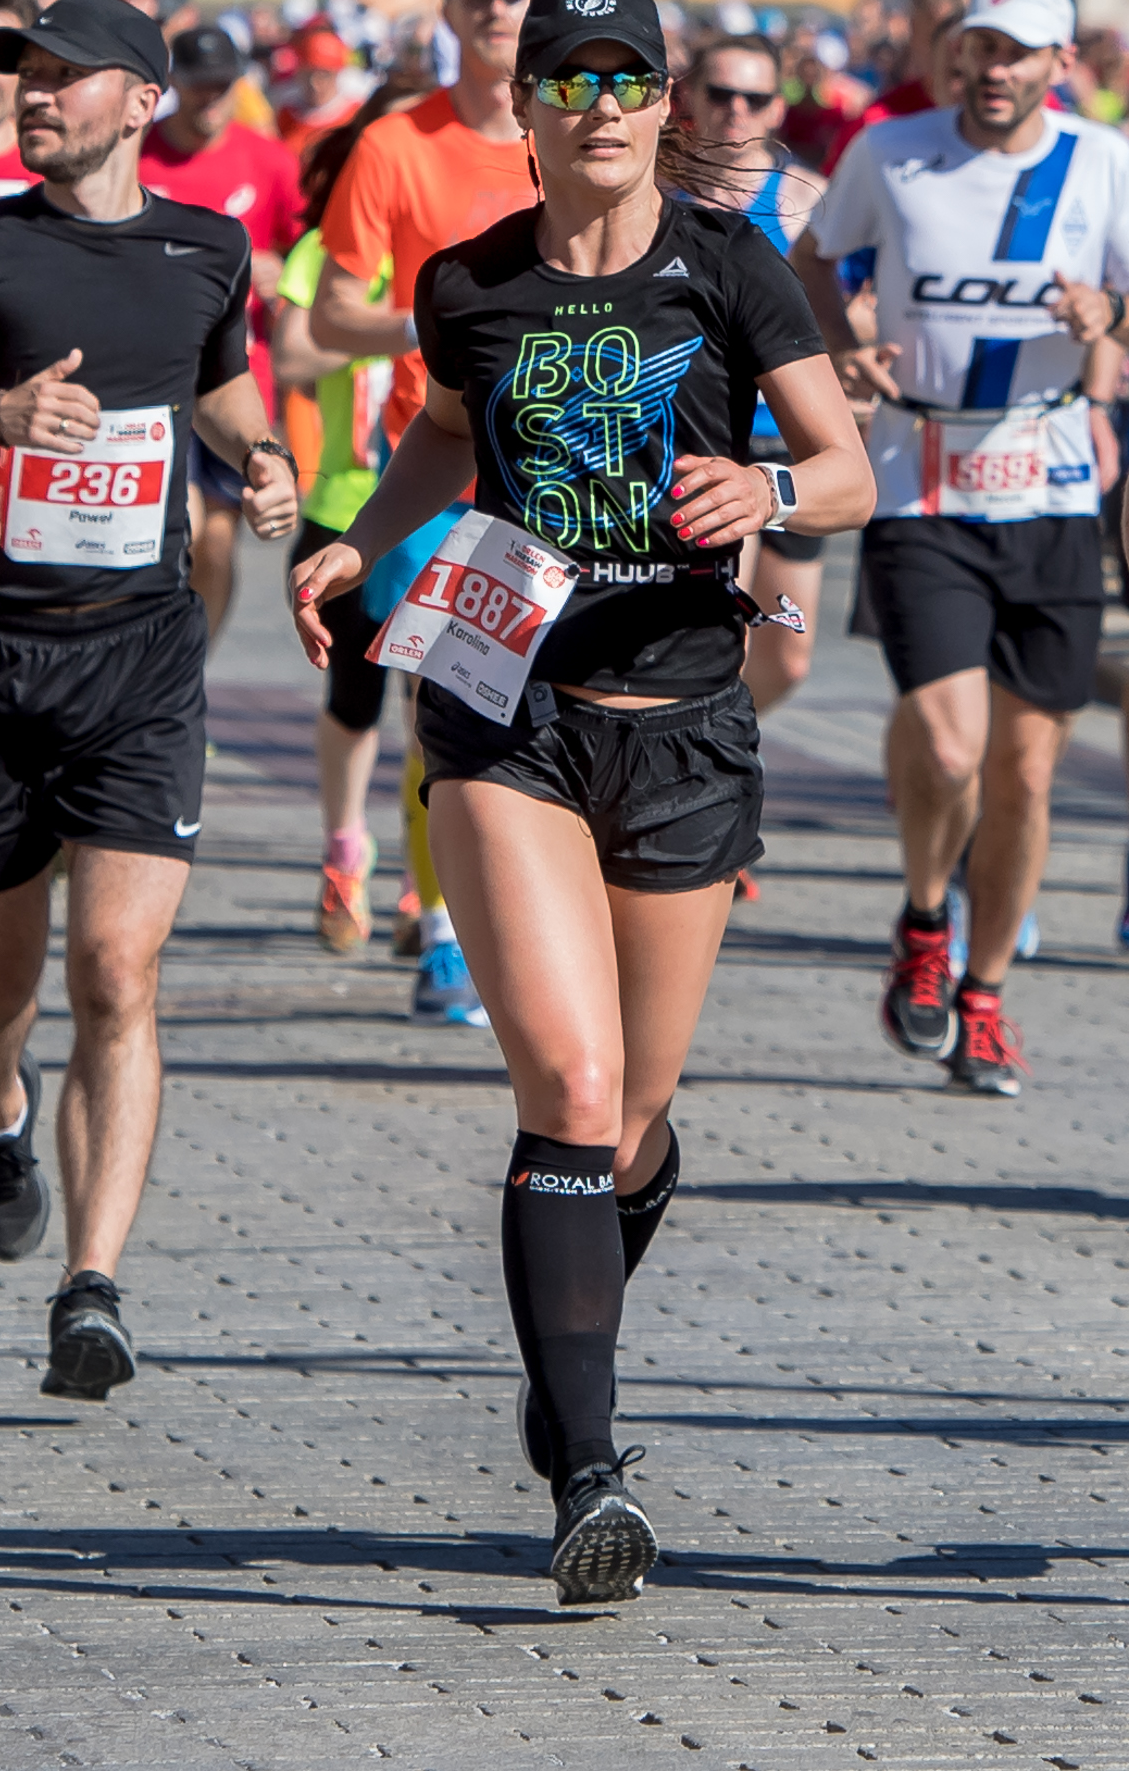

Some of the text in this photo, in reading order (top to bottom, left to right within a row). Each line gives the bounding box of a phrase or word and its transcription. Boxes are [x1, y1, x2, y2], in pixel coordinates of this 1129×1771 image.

[555, 303, 613, 316] HELLO
[46, 462, 142, 506] 236
[593, 562, 675, 584] HUUB
[418, 564, 534, 641] 1887
[447, 620, 490, 656] Karolina
[390, 645, 423, 660] ORLEN
[530, 1172, 595, 1190] ROYAL
